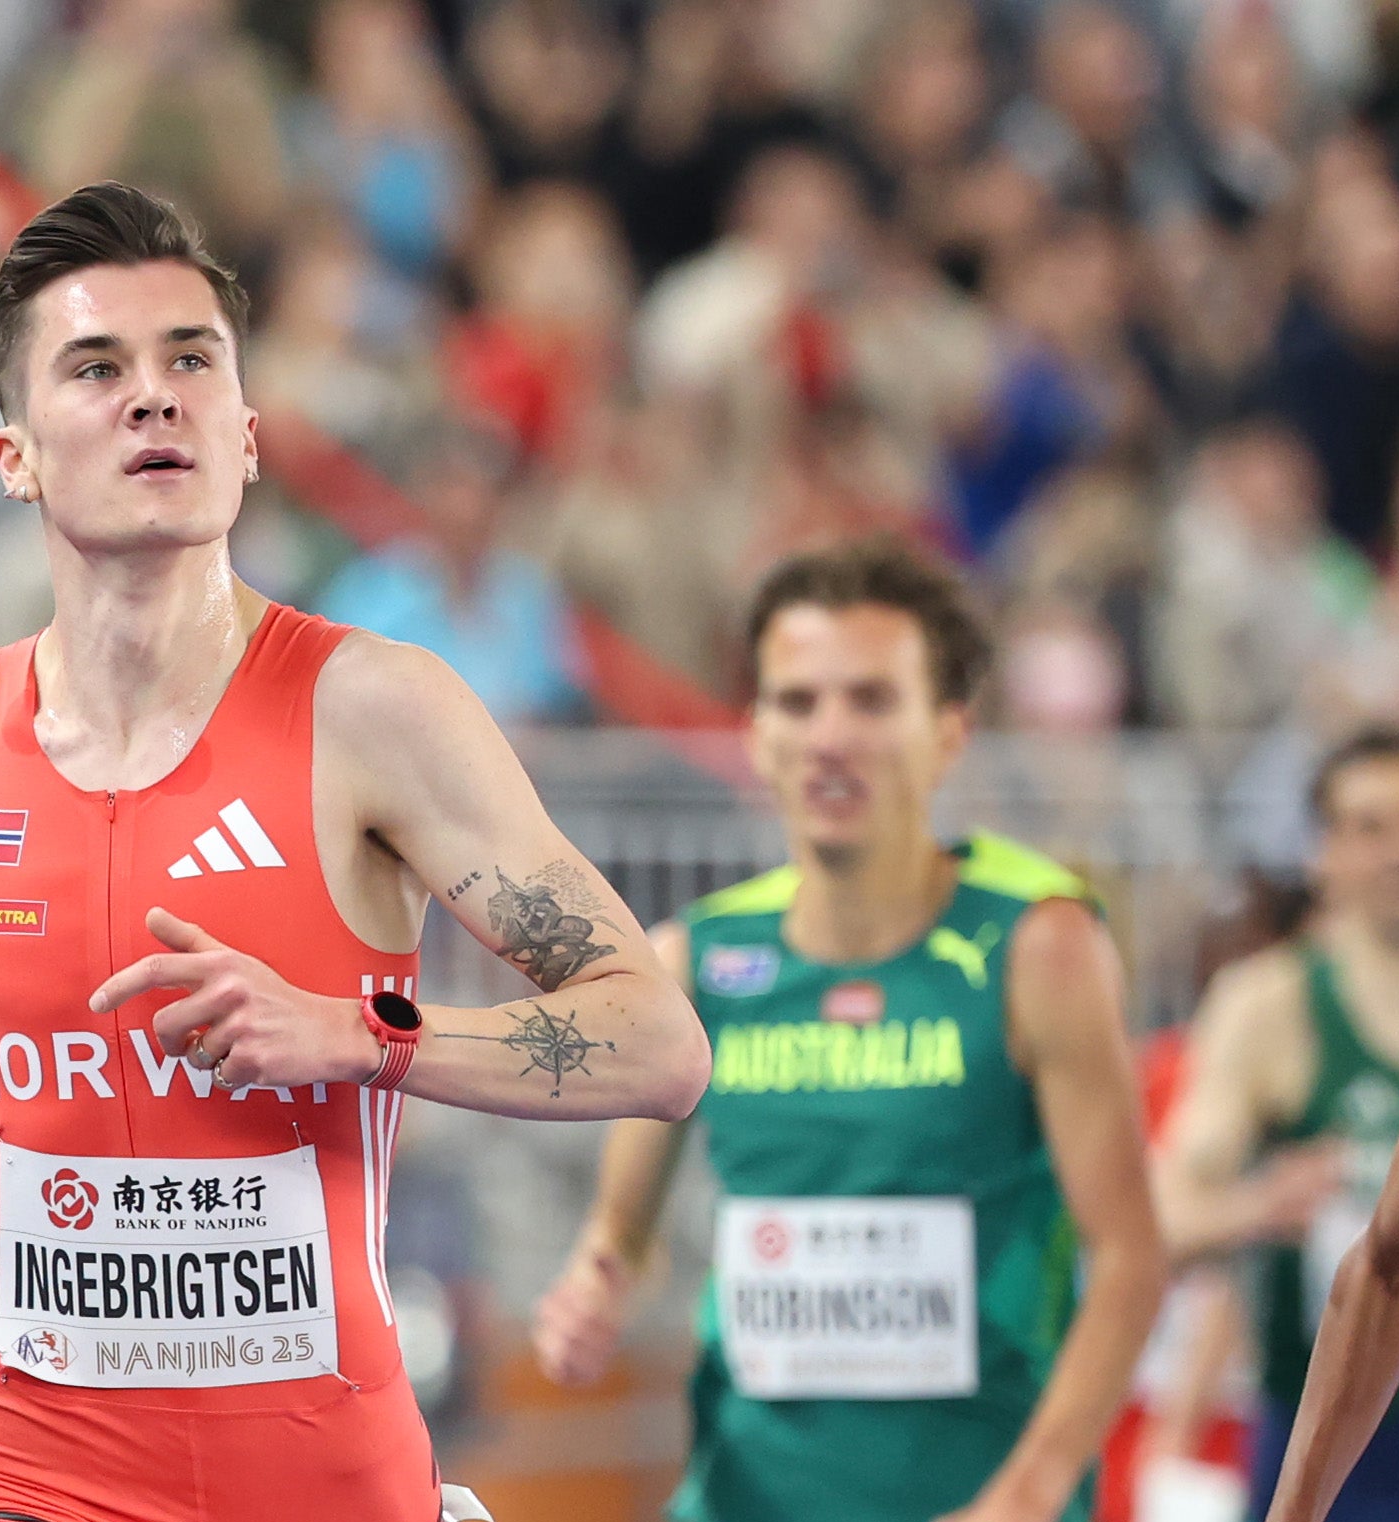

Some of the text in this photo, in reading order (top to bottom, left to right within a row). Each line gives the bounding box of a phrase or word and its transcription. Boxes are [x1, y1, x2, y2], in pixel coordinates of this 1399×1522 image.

[447, 871, 482, 901] fast
[712, 1018, 965, 1093] AUSTRALIA
[113, 1174, 267, 1214] 南京银行
[115, 1215, 268, 1231] BANK OF NANJING
[14, 1241, 319, 1320] INGEBRIGTSEN
